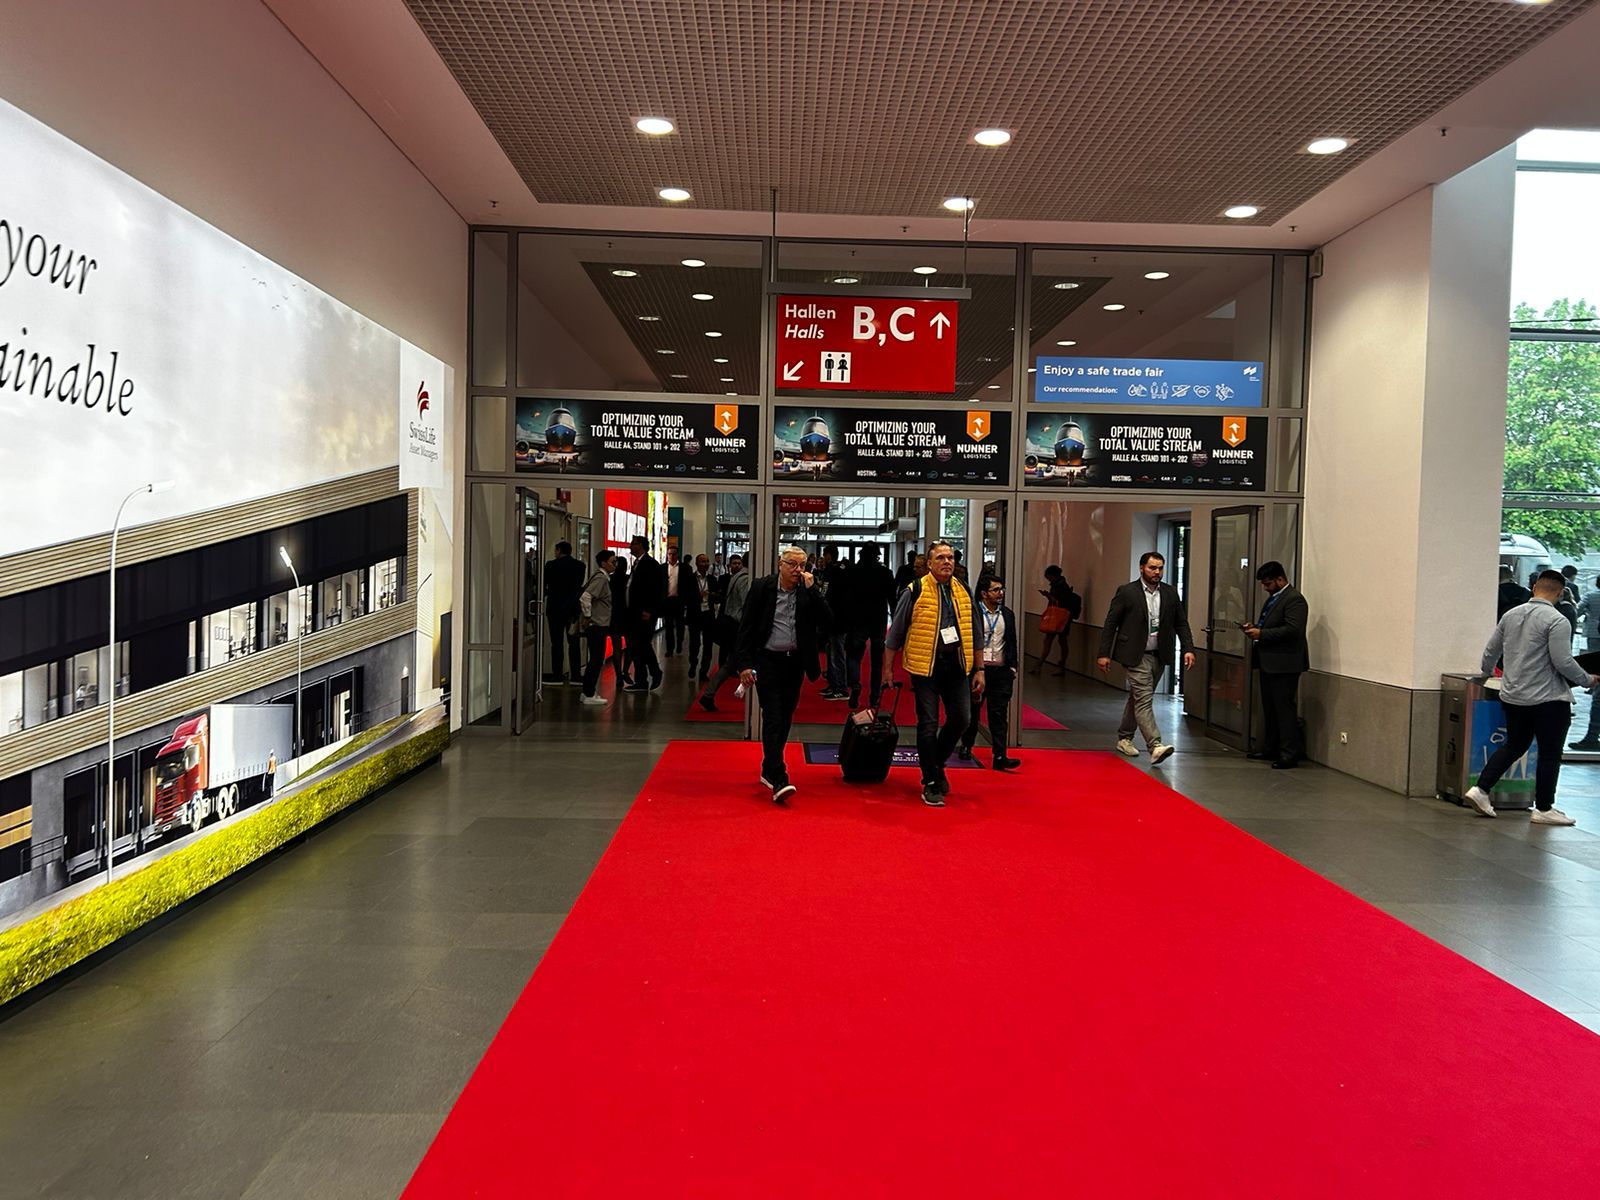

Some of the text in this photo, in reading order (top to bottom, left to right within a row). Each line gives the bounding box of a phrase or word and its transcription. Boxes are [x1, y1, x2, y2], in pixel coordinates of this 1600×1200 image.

[0, 219, 97, 294] your
[784, 323, 825, 339] Halls
[785, 304, 916, 347] Hallen B,C
[1044, 365, 1164, 377] Enjoy a safe trade fair
[1058, 386, 1118, 394] recommendation:
[602, 412, 684, 428] OPTIMIZING YOUR
[590, 425, 694, 440] TOTAL VALUE STREAM
[855, 421, 936, 434] OPTIMIZING YOUR
[1110, 426, 1191, 439] OPTIMIZING YOUR
[604, 441, 622, 449] HALLE
[633, 442, 652, 450] STAND
[652, 443, 662, 451] 101
[669, 443, 681, 451] 202
[705, 437, 746, 448] NUNNER
[844, 433, 946, 447] TOTAL VALUE STREAM
[1099, 438, 1202, 452] TOTAL VALUE STREAM
[857, 448, 875, 456] HALLE
[886, 449, 904, 457] STAND
[904, 449, 914, 458] 101
[922, 450, 933, 458] 202
[956, 443, 998, 454] NUNNER
[1212, 449, 1254, 459] NUNNER
[1111, 453, 1130, 462] HALLE
[1140, 454, 1159, 463] STAND
[1160, 455, 1169, 463] 101
[1177, 455, 1188, 463] 202
